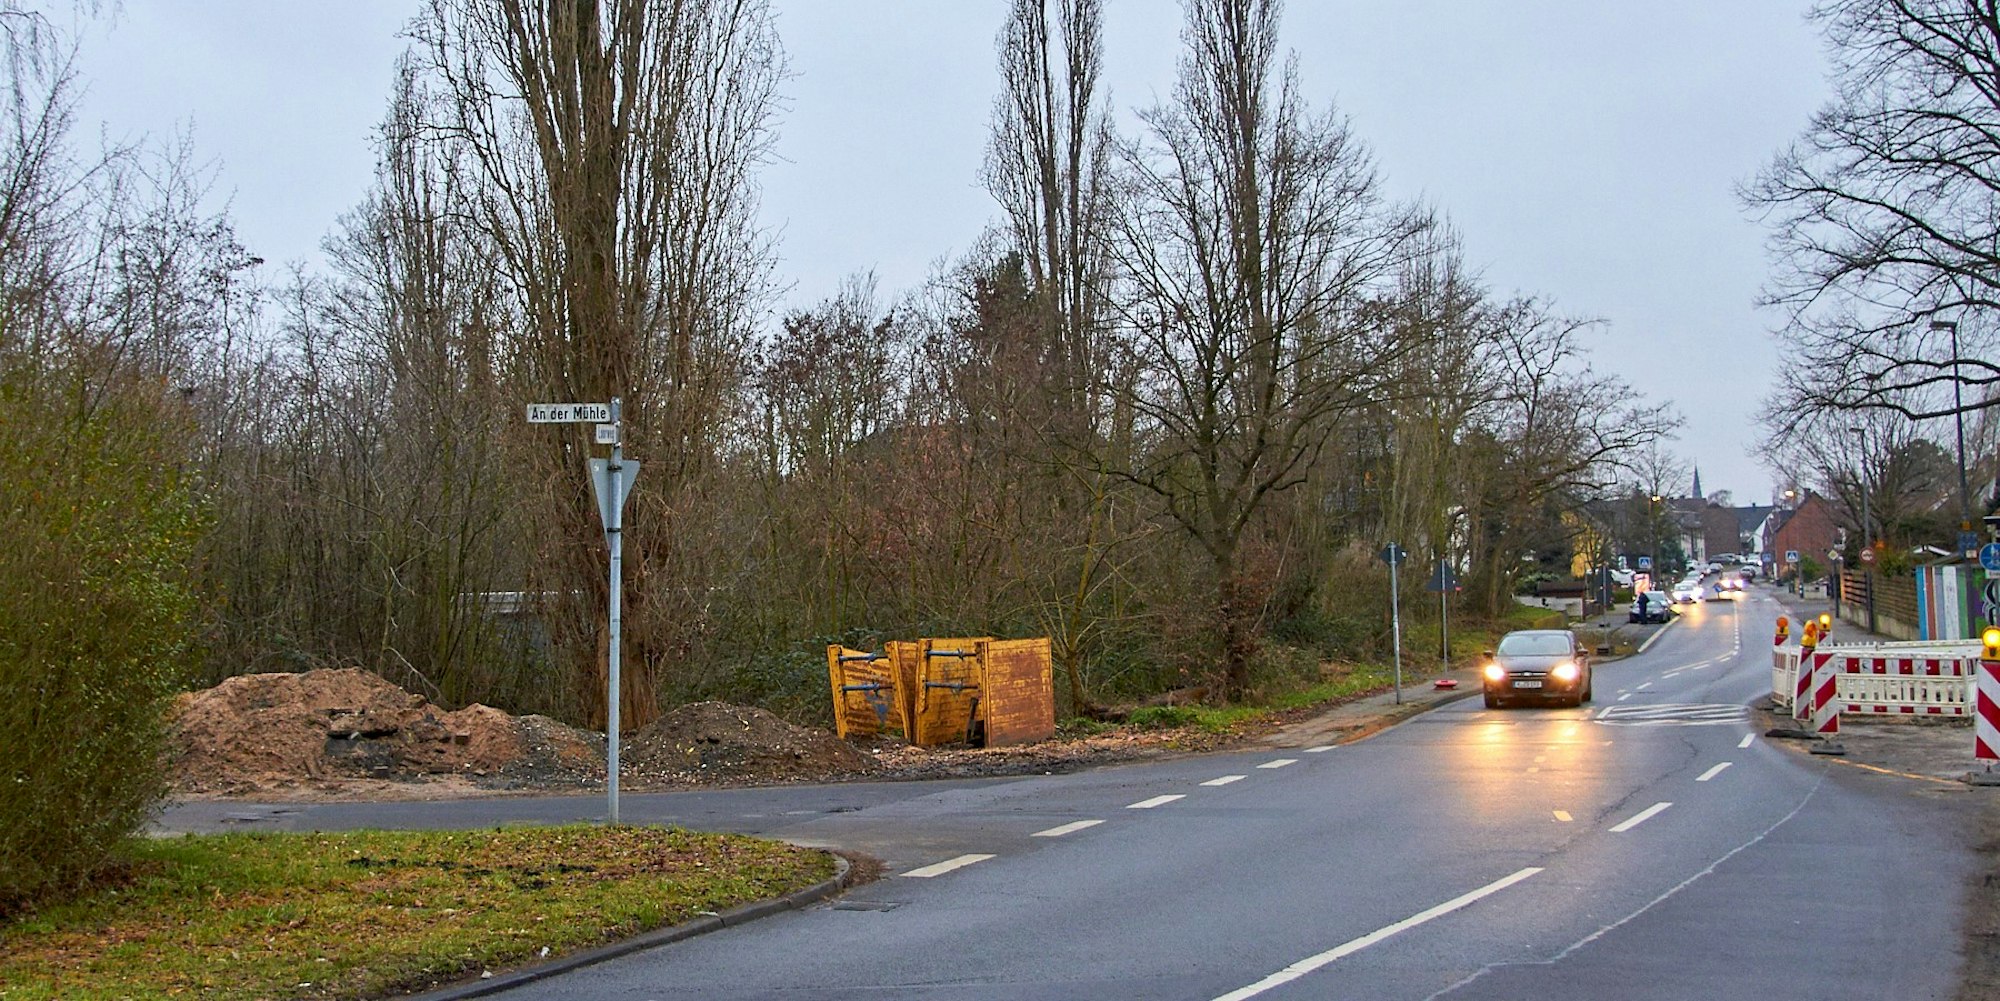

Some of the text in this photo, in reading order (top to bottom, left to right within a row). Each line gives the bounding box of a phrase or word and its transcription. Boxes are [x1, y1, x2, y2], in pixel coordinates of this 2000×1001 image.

[531, 406, 607, 420] An der Mühle
